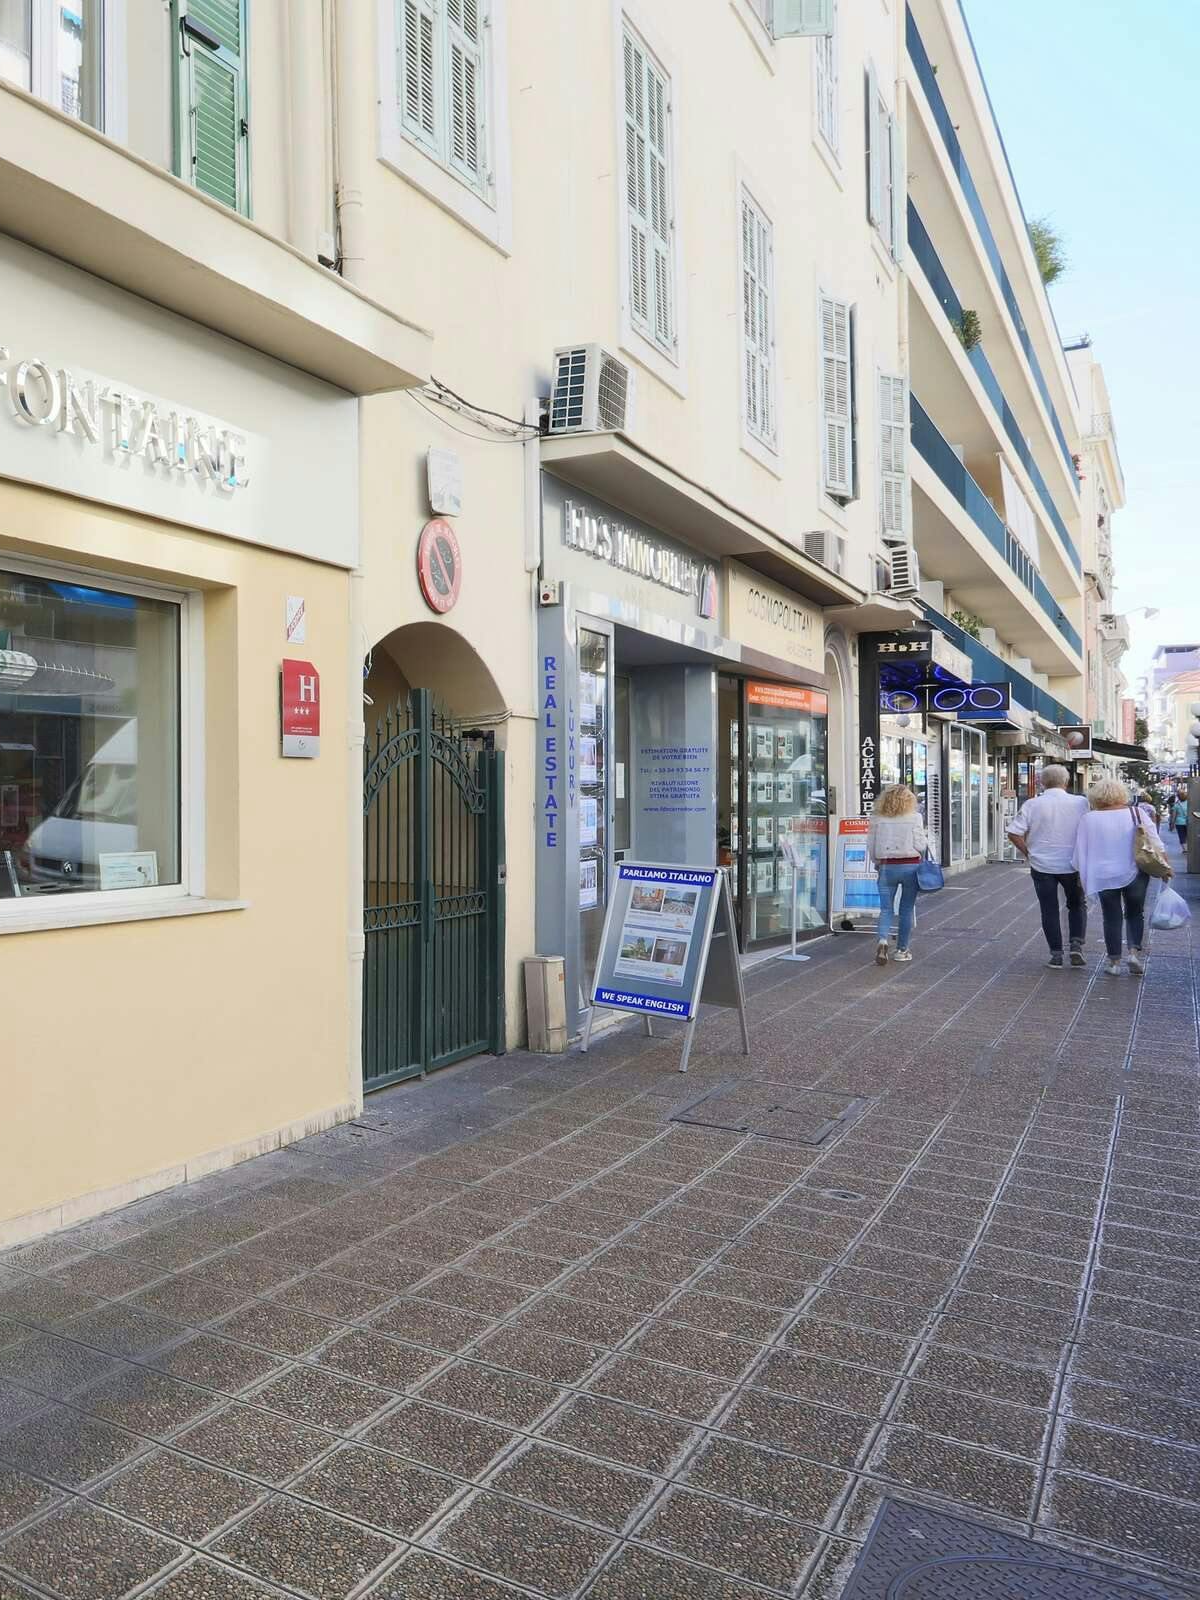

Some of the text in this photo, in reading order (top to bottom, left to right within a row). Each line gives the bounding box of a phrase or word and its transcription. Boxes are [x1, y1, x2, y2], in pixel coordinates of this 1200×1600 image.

[299, 674, 317, 703] H
[544, 657, 558, 847] REAL ESTATE
[568, 698, 576, 808] LUXURY
[861, 736, 876, 790] ACHAT
[862, 791, 874, 800] de
[623, 868, 712, 883] PARLIAMO ITALIANO
[601, 991, 684, 1012] WE SPEAK ENGLISH
